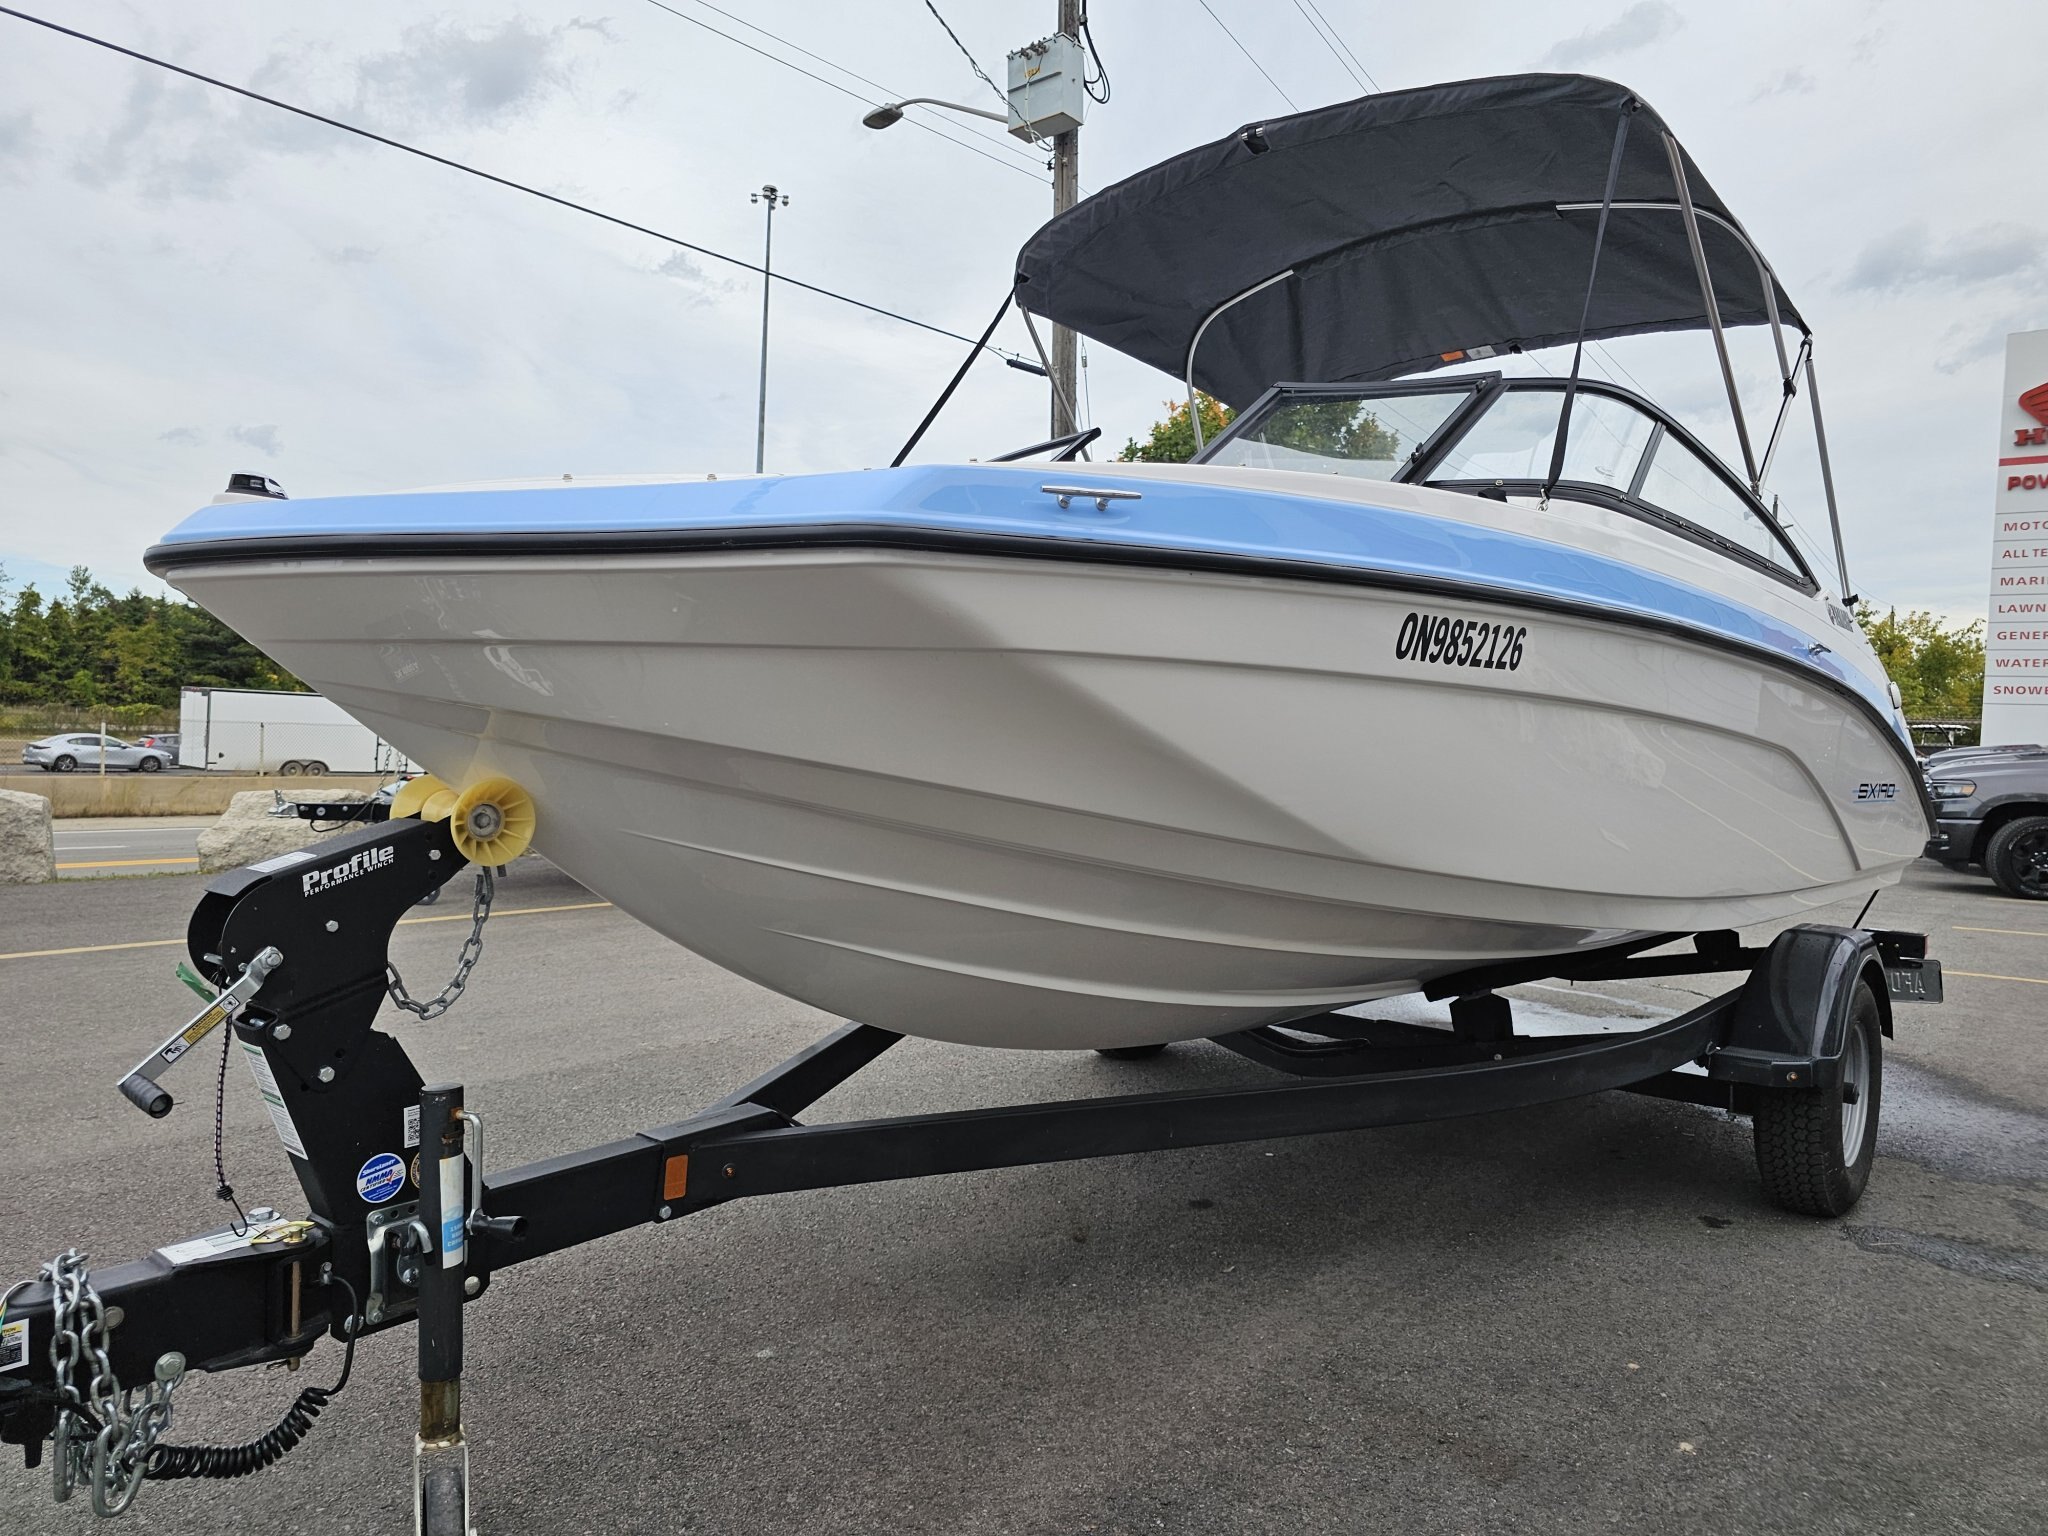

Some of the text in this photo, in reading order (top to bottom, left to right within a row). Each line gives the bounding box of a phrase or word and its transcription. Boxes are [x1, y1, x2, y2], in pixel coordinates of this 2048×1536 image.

[2013, 427, 2048, 446] H
[2002, 548, 2048, 559] ALL TE
[2000, 576, 2048, 586] MARI
[1998, 603, 2046, 614] LAWN
[1395, 612, 1527, 671] ON9852126
[302, 845, 394, 892] Profile
[304, 858, 394, 898] PERFORMANCE WINCH
